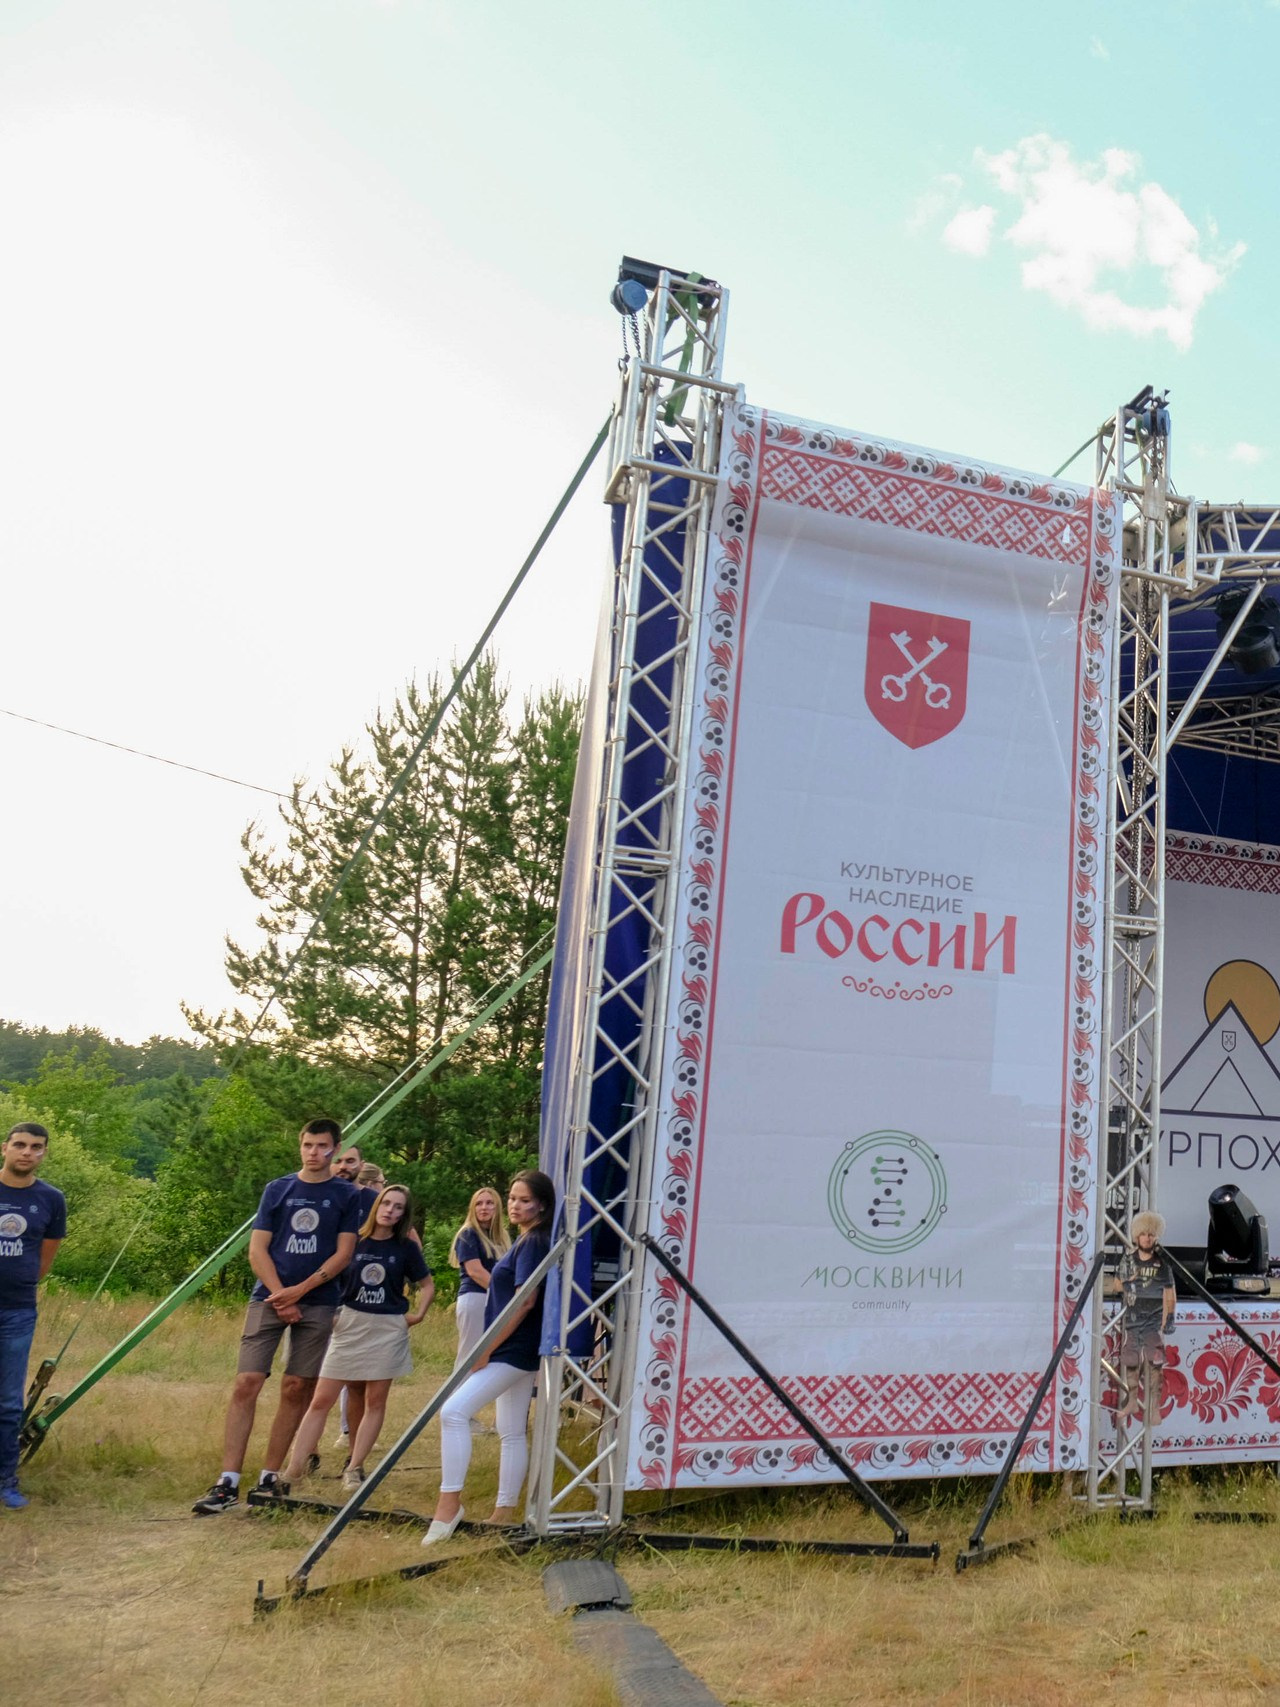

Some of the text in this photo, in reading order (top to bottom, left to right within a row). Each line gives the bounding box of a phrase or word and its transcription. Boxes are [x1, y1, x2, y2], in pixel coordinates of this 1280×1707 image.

[840, 861, 974, 892] КУЛЬТУРНОЕ
[849, 887, 963, 914] НАСЛЕДИЕ
[800, 1265, 963, 1288] МОСКВИЧИ
[851, 1298, 912, 1312] community
